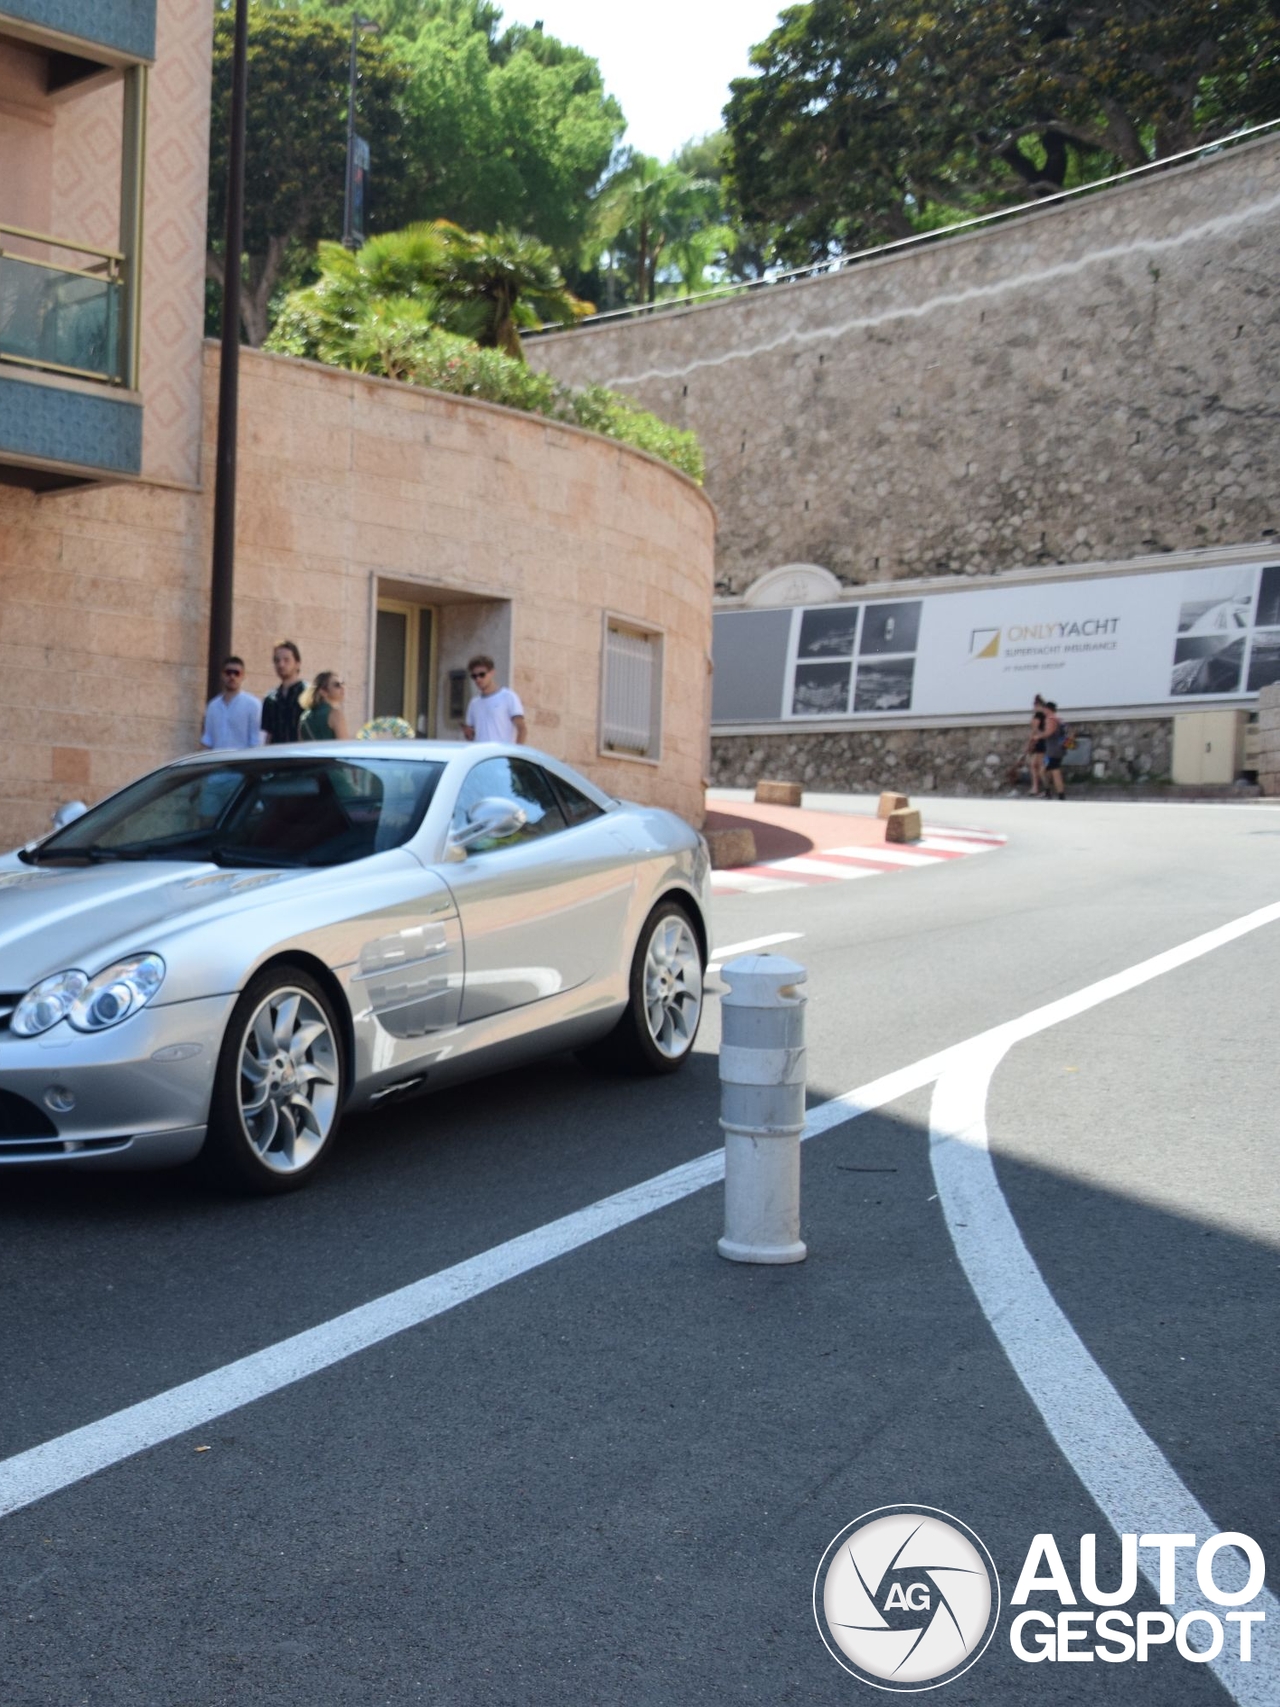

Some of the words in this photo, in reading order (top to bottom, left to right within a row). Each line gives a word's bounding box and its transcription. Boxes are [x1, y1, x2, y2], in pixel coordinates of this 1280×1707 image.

[1007, 617, 1120, 642] ONLYYACHT
[1005, 646, 1061, 658] SUPERYACHT
[1064, 641, 1118, 653] INSURANCE
